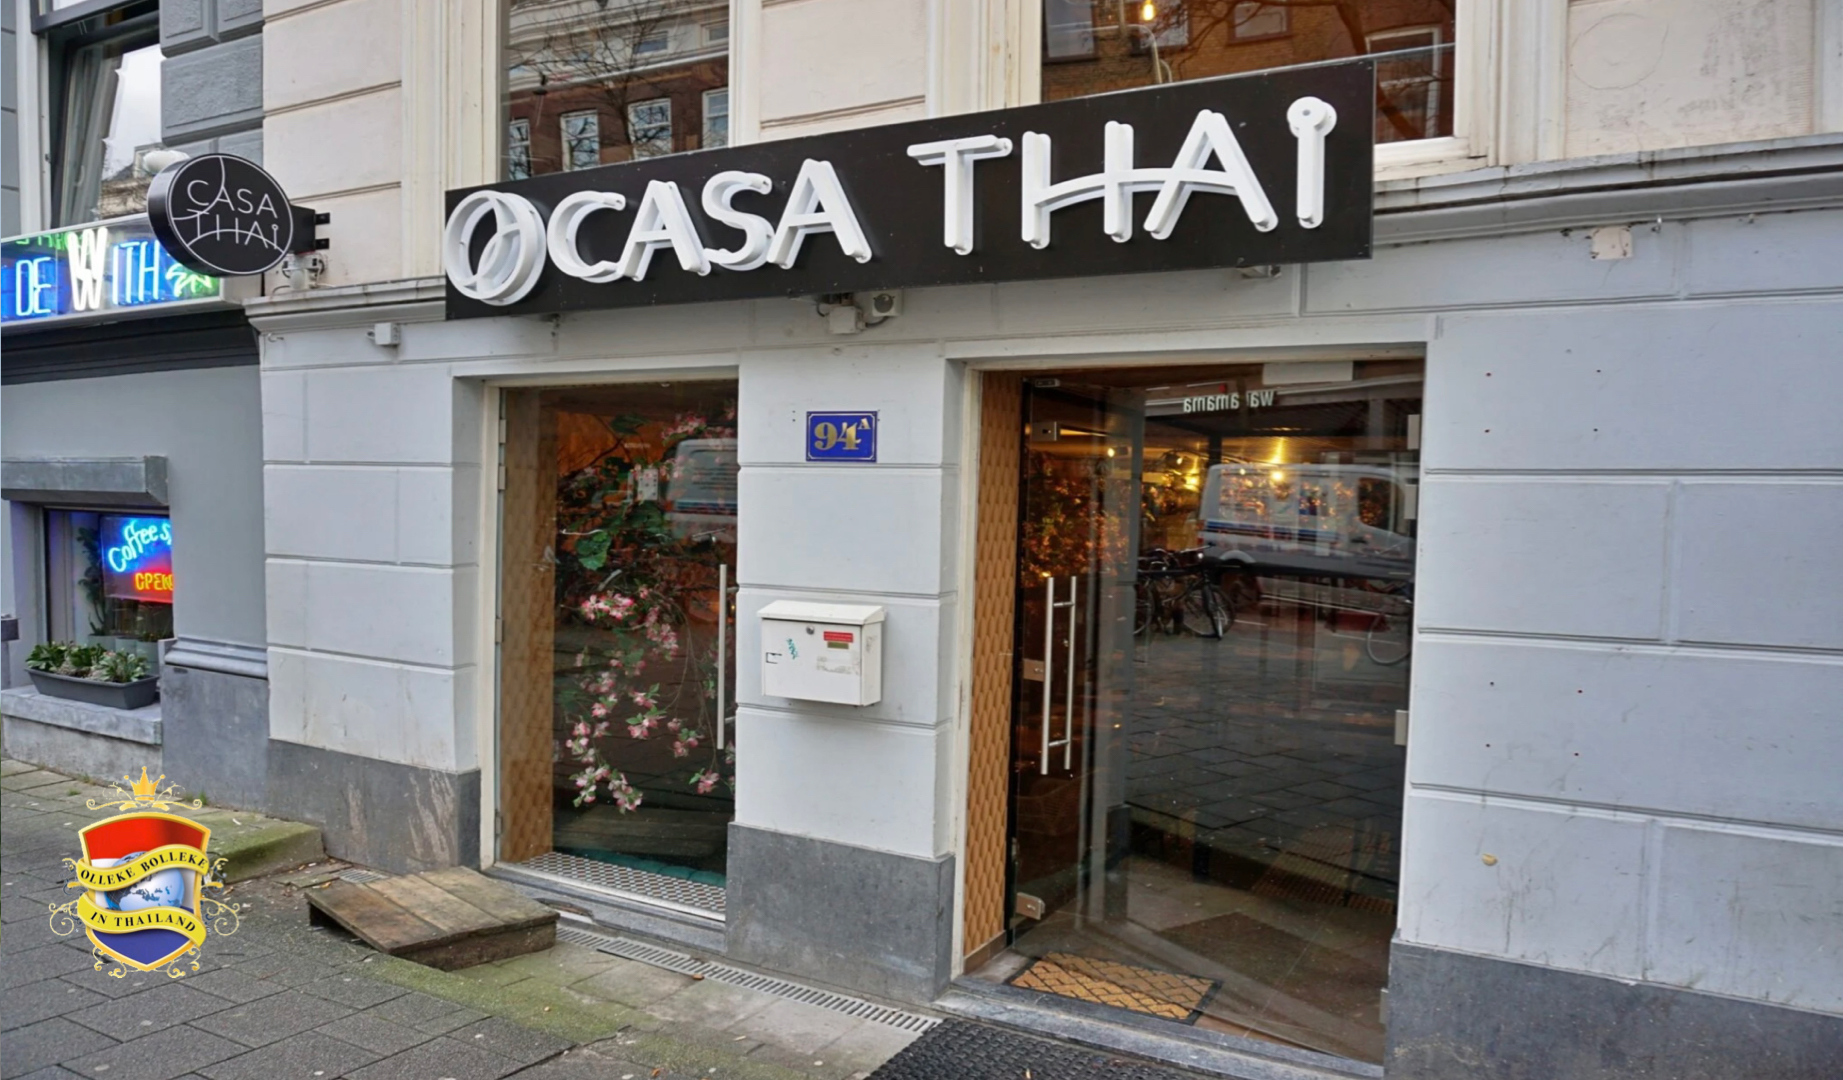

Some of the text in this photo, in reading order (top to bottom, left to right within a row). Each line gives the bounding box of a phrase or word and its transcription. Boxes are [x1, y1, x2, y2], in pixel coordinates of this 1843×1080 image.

[186, 180, 278, 219] CASA
[547, 159, 872, 283] CASA
[15, 256, 51, 317] DE
